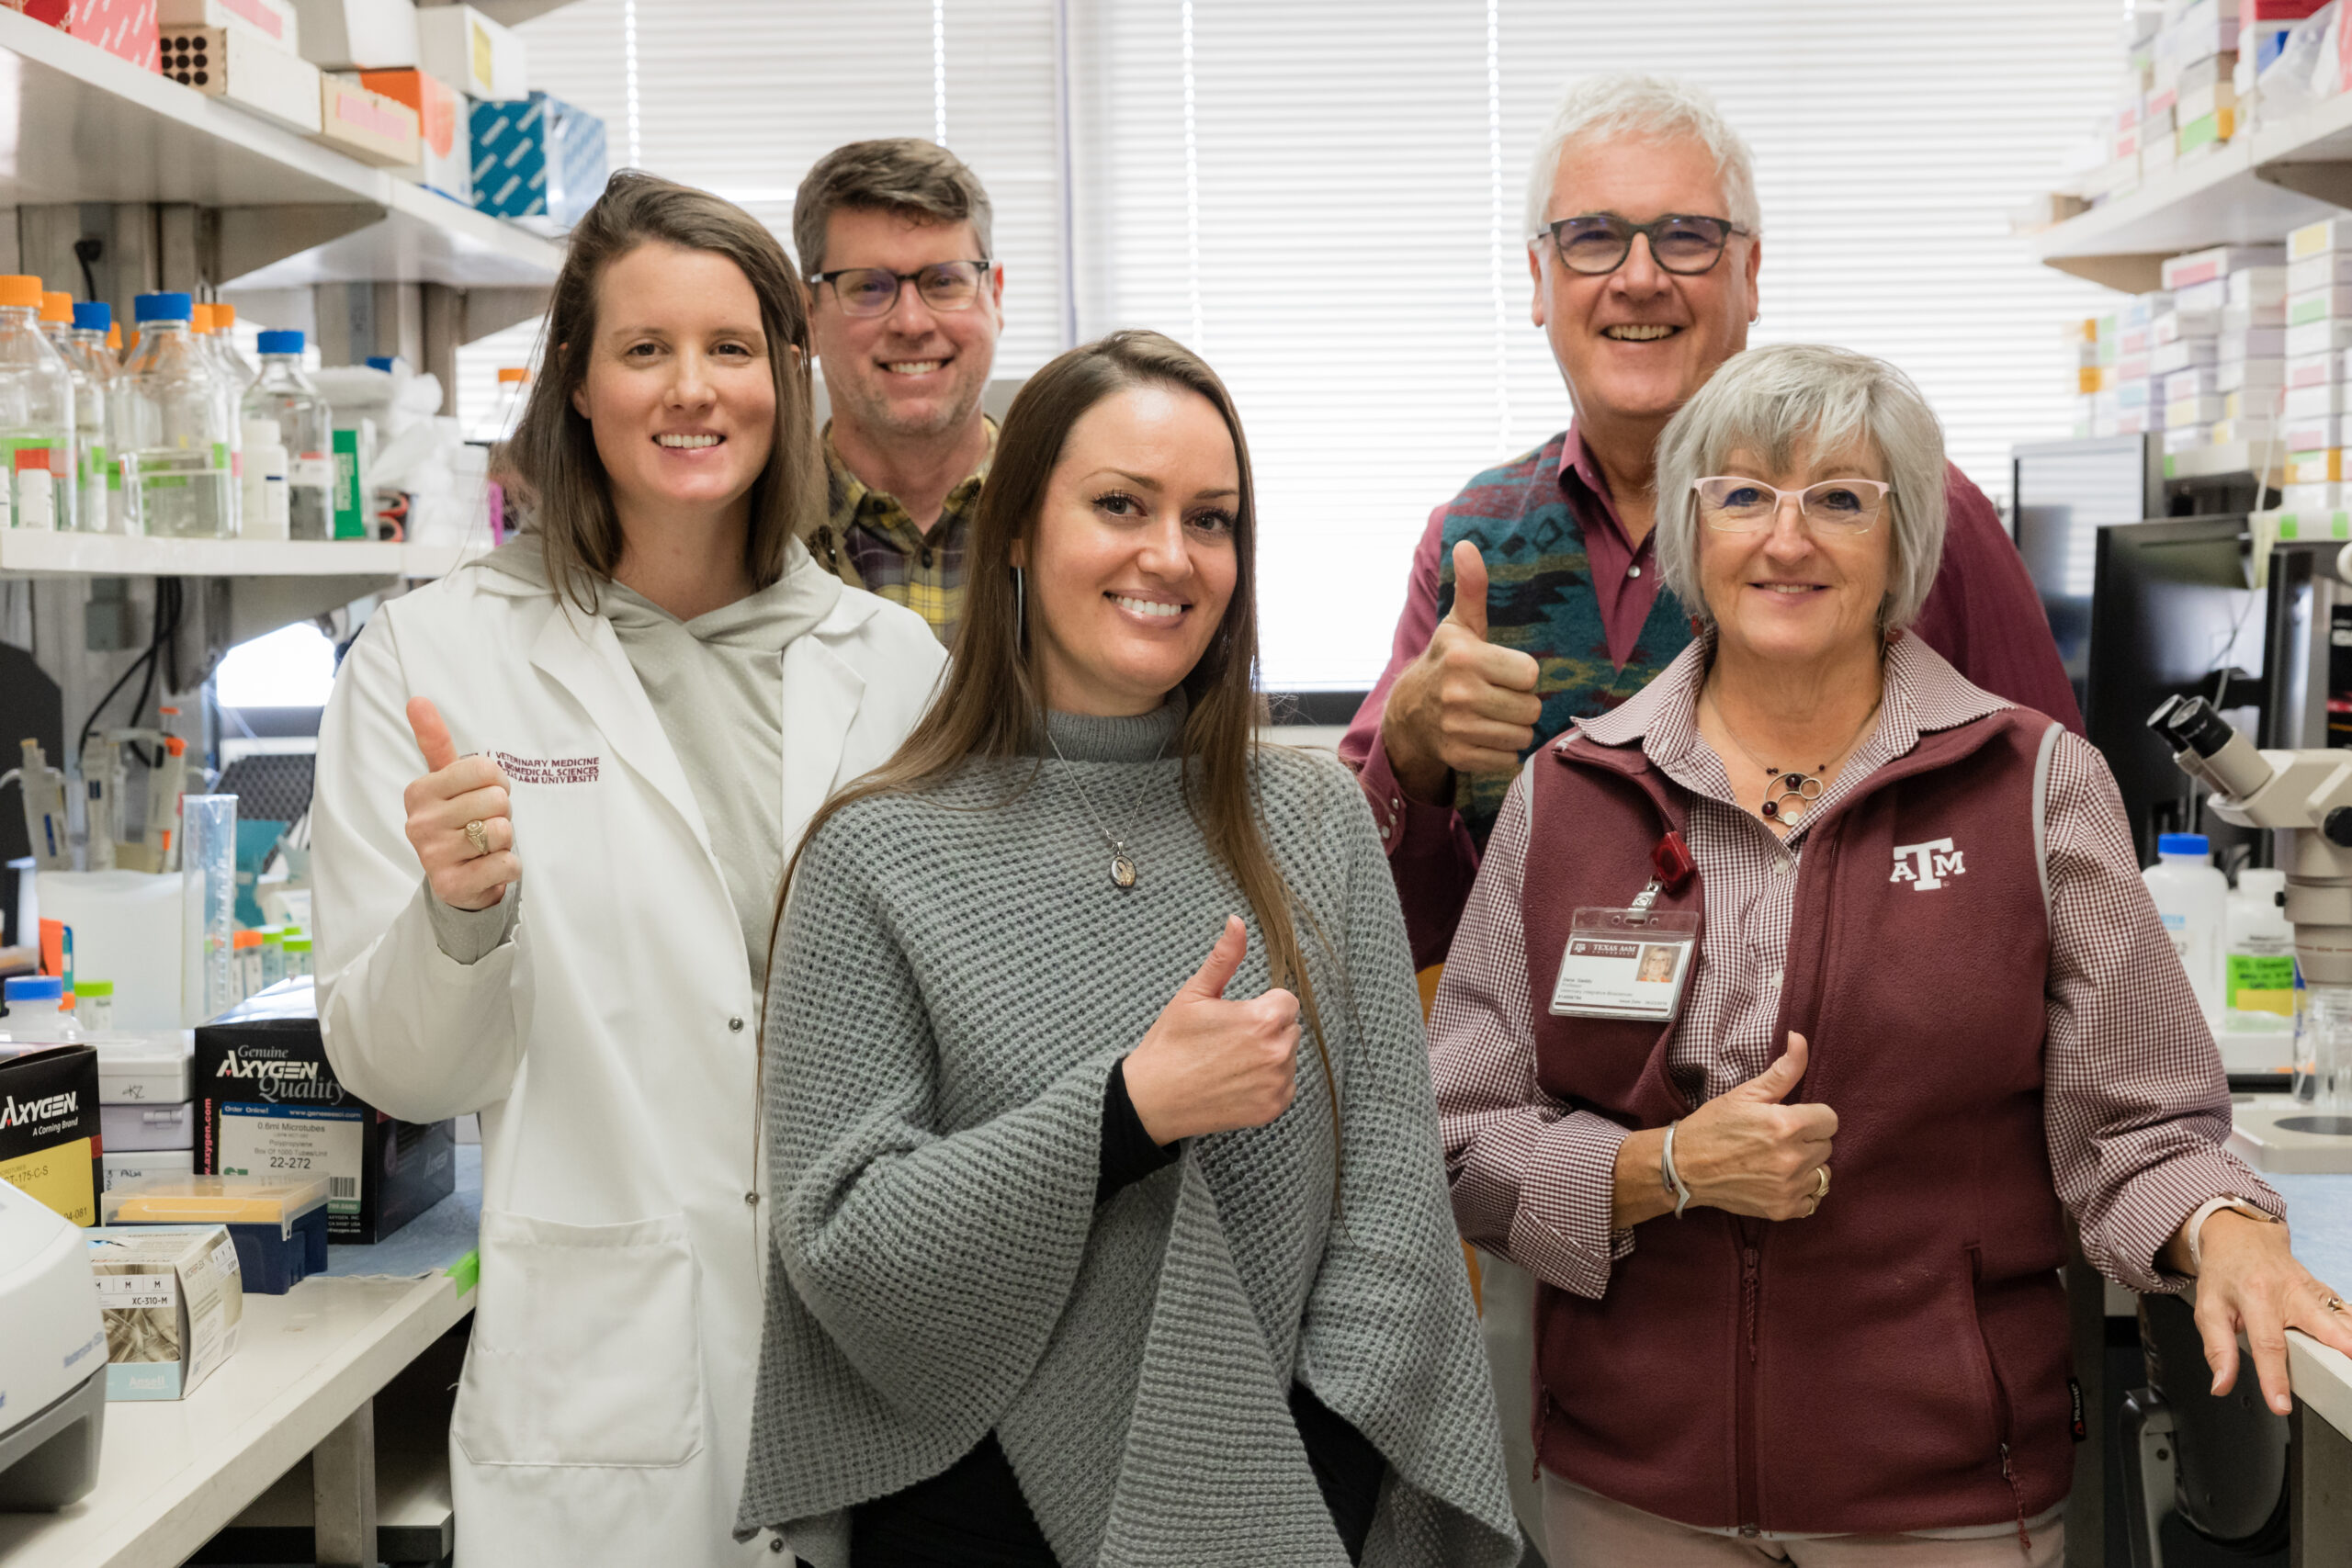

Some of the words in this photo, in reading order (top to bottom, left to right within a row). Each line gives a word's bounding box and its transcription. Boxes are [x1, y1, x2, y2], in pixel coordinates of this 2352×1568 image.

[496, 751, 548, 768] VETERINARY
[551, 757, 600, 768] MEDICINE
[504, 761, 553, 777] BIOMEDICAL
[557, 765, 599, 777] SCIENCES
[518, 774, 538, 784] A&M
[541, 773, 599, 784] UNIVERSITY
[1593, 943, 1618, 952] TEXAS
[237, 1044, 289, 1058] Genuine
[216, 1050, 319, 1079] AXYGEN
[258, 1073, 345, 1106] Quality
[224, 1104, 243, 1113] Order
[245, 1105, 269, 1114] Online!
[32, 1127, 38, 1136] A
[38, 1121, 62, 1136] Corning
[62, 1116, 79, 1130] Brand
[282, 1122, 325, 1134] Microtubes
[270, 1156, 311, 1169] 22-272
[131, 1296, 168, 1305] XC-310-M
[129, 1374, 166, 1388] Ansell
